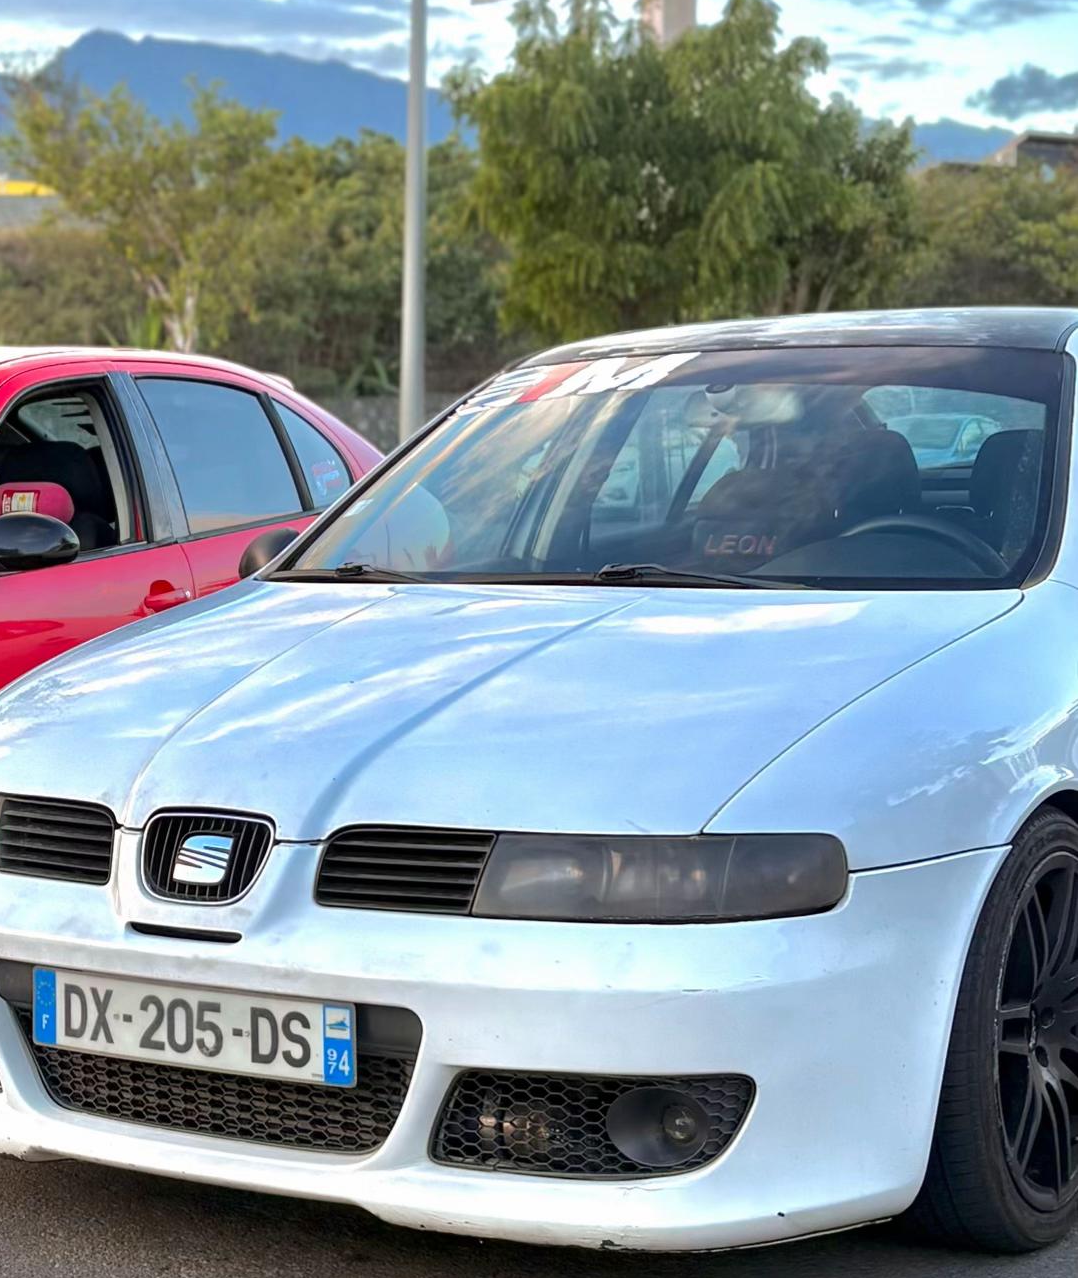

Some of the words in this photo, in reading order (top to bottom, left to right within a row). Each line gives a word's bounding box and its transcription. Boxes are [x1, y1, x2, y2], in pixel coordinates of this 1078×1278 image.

[704, 534, 777, 555] LEON
[42, 1013, 50, 1030] F
[63, 982, 312, 1069] DX-205-DS
